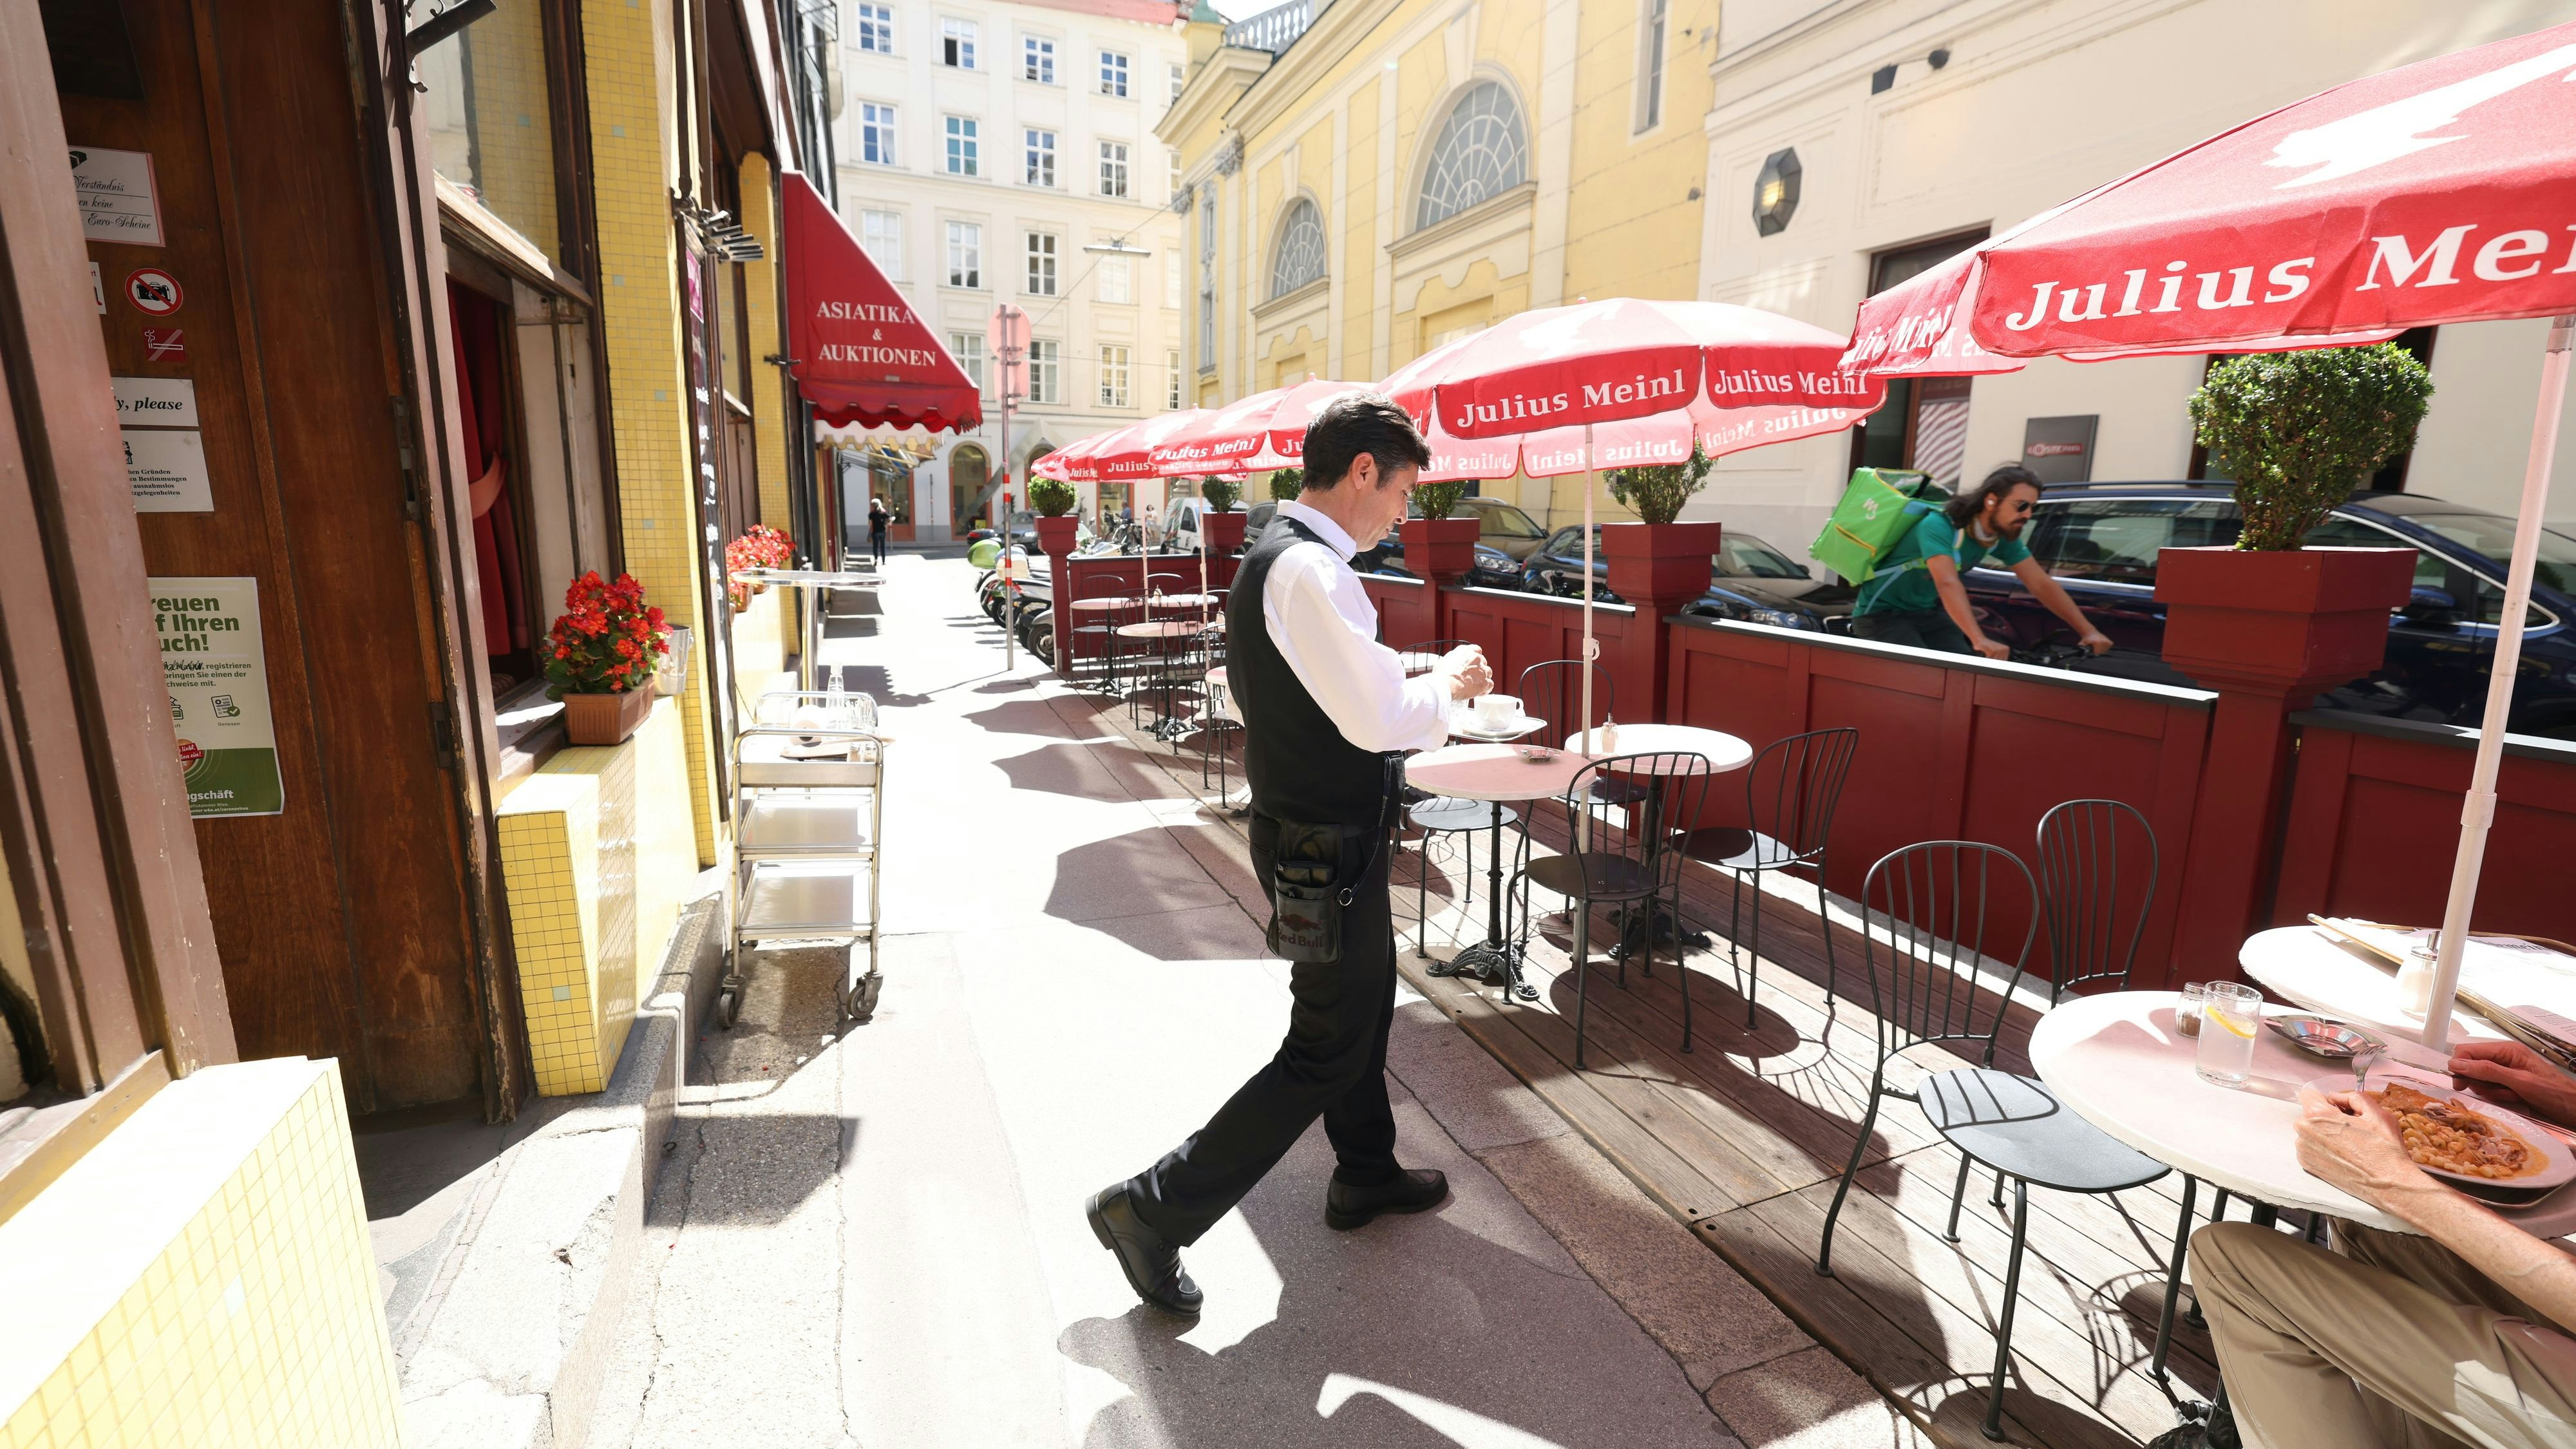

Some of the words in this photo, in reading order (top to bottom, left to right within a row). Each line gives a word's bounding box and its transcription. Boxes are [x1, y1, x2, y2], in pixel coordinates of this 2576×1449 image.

[91, 195, 113, 209] keine
[88, 213, 151, 229] Euro-Scheine
[2005, 257, 2315, 332] Julius
[817, 301, 915, 324] ASIATIKA
[872, 328, 882, 341] &
[818, 344, 936, 366] AUKTIONEN
[1714, 369, 1794, 395] Julius
[1797, 370, 1869, 395] Meinl
[134, 397, 183, 412] please
[1457, 392, 1569, 428] Julius
[1582, 368, 1687, 408] Meinl
[1155, 446, 1209, 460] Julius
[1211, 437, 1256, 456] Meinl
[1107, 461, 1150, 473] Julius
[155, 614, 166, 632] f
[172, 613, 240, 632] Ihren
[158, 634, 209, 652] uch!
[205, 662, 252, 670] registrieren
